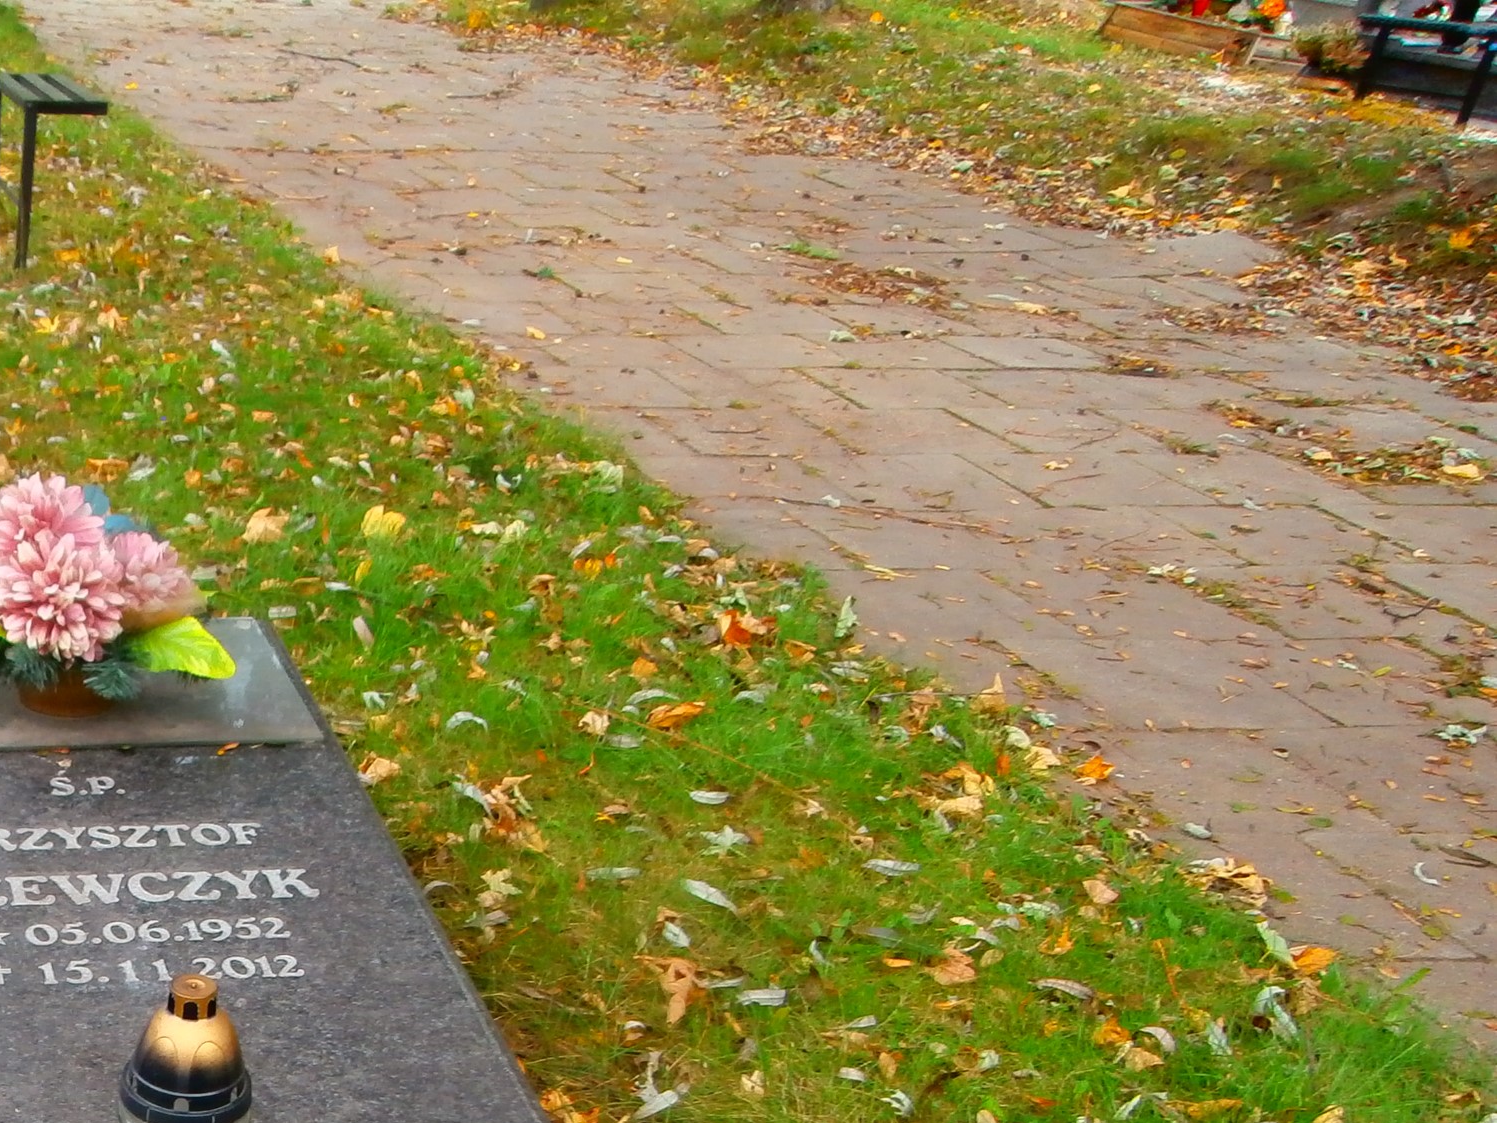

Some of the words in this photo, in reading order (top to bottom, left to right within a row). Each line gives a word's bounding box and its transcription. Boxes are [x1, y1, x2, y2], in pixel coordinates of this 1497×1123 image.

[50, 766, 127, 797] Ś.P.
[24, 917, 292, 946] 05.06.1952
[38, 955, 305, 986] 15.112012
